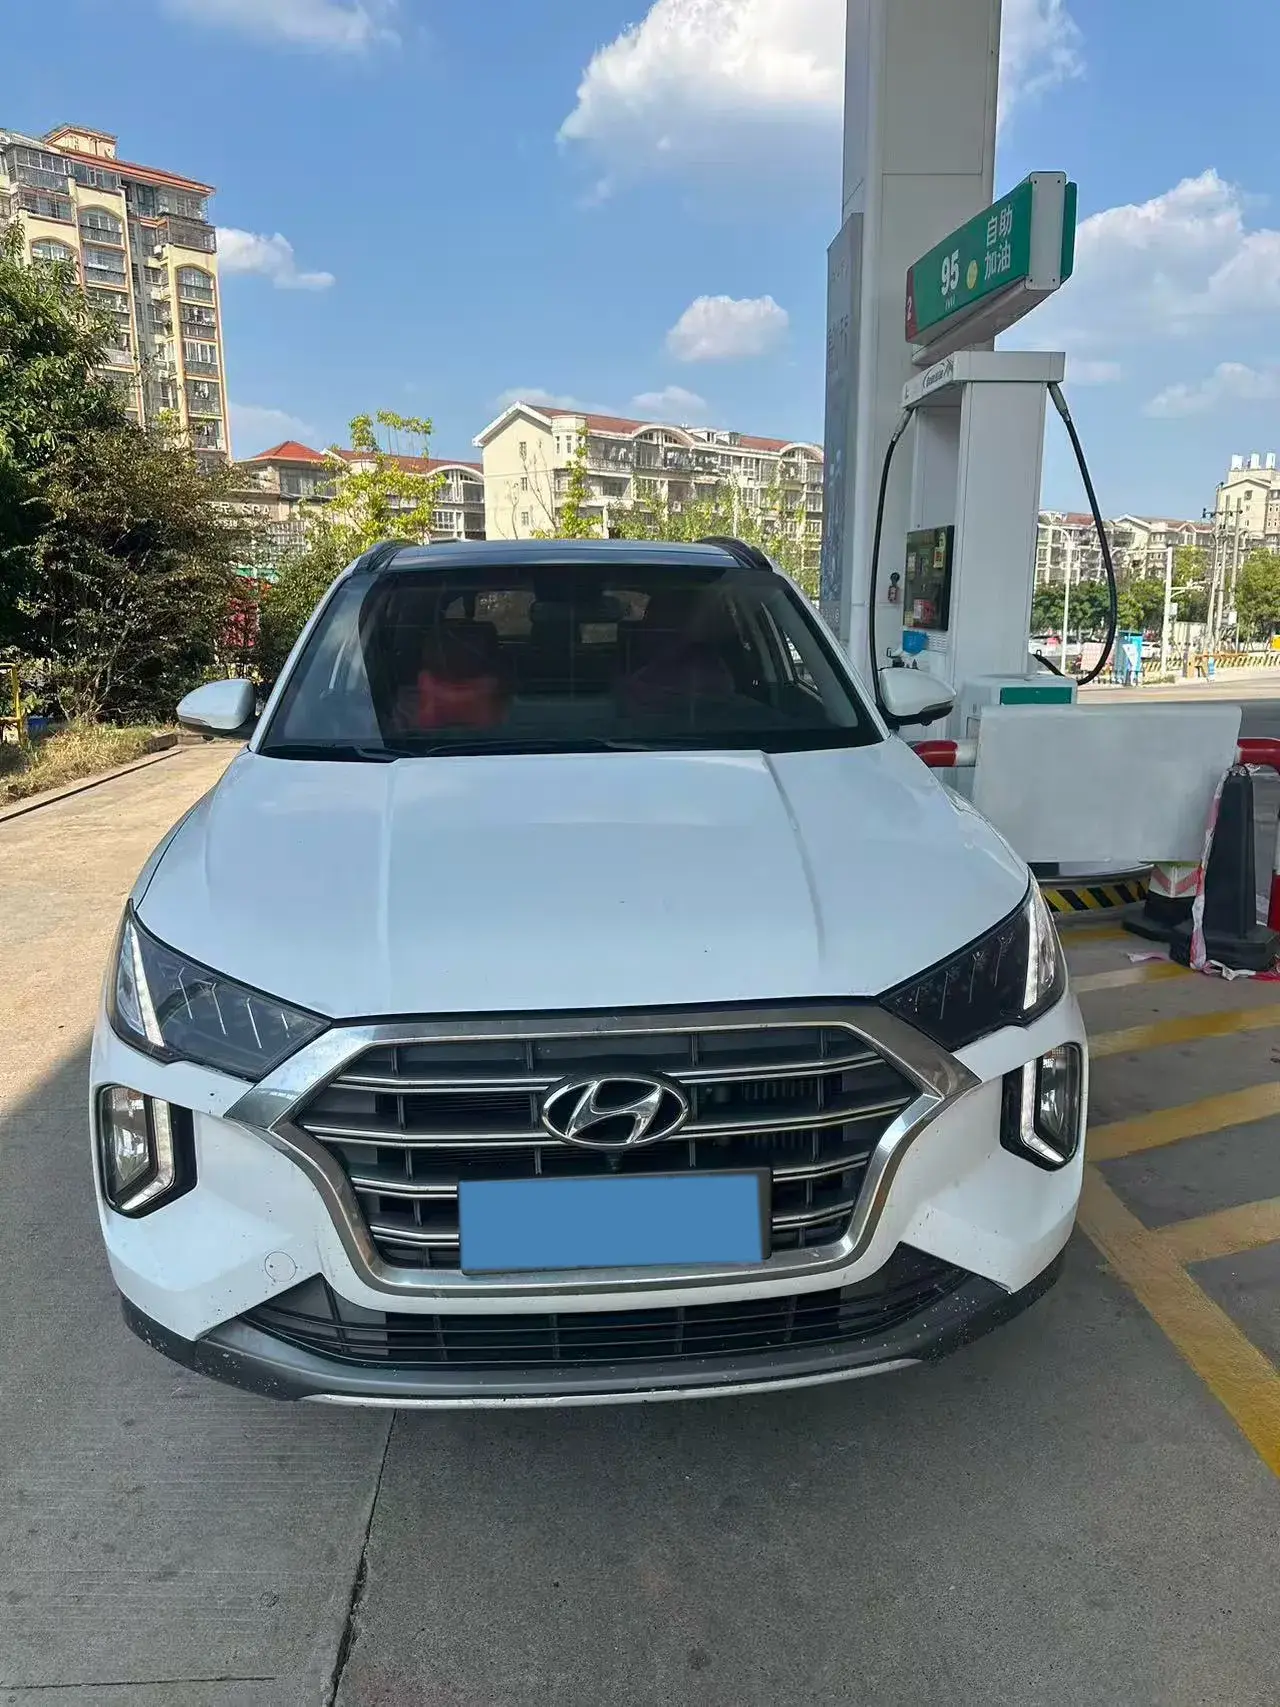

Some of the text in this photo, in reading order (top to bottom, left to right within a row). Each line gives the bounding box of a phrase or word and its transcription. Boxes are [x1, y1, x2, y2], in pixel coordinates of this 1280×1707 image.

[986, 205, 1013, 246] 自助
[941, 249, 960, 295] 95
[984, 240, 1011, 280] 加油
[906, 295, 913, 321] 2
[241, 503, 271, 516] SPA
